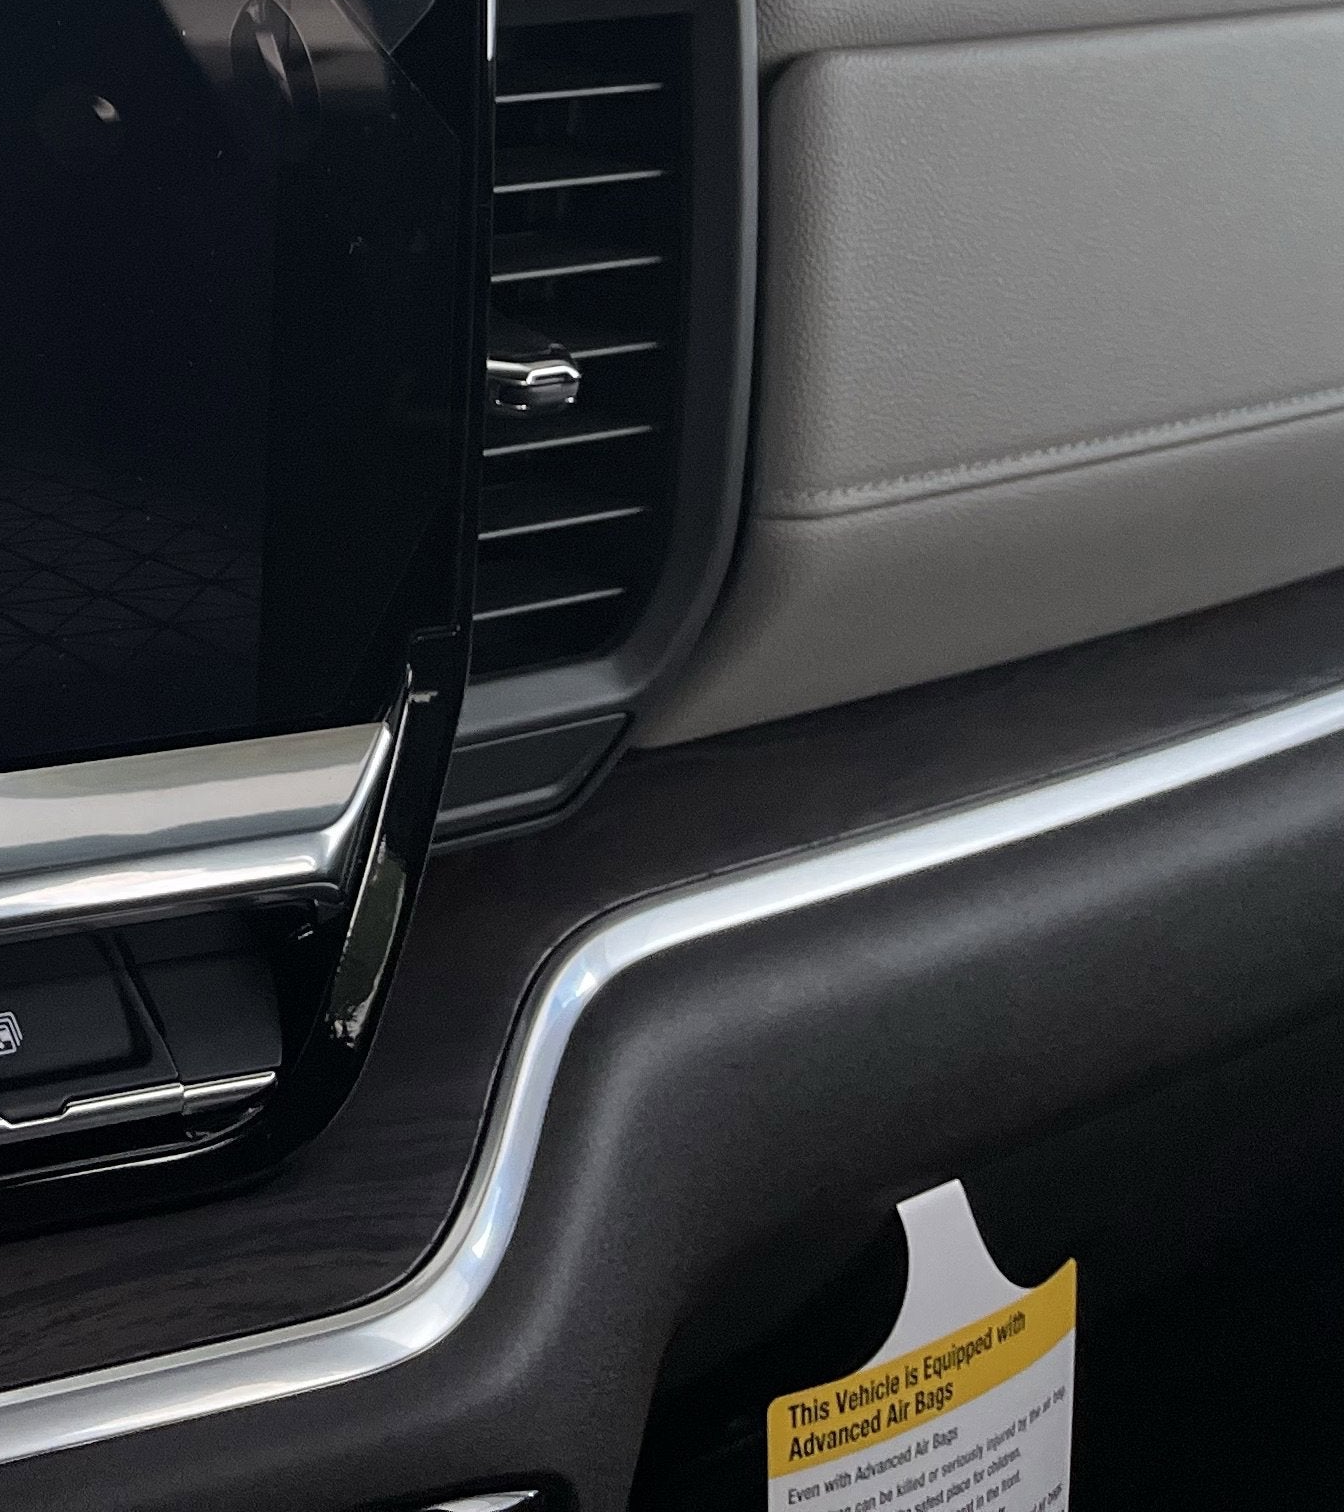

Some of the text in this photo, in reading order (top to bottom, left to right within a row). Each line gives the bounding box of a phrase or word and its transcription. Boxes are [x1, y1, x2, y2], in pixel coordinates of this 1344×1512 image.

[788, 1311, 1026, 1429] This Vehicle is Equipped with
[788, 1382, 954, 1462] Advanced Air Bags
[824, 1471, 852, 1493] with
[855, 1445, 912, 1483] Advanced
[933, 1426, 959, 1449] Bags
